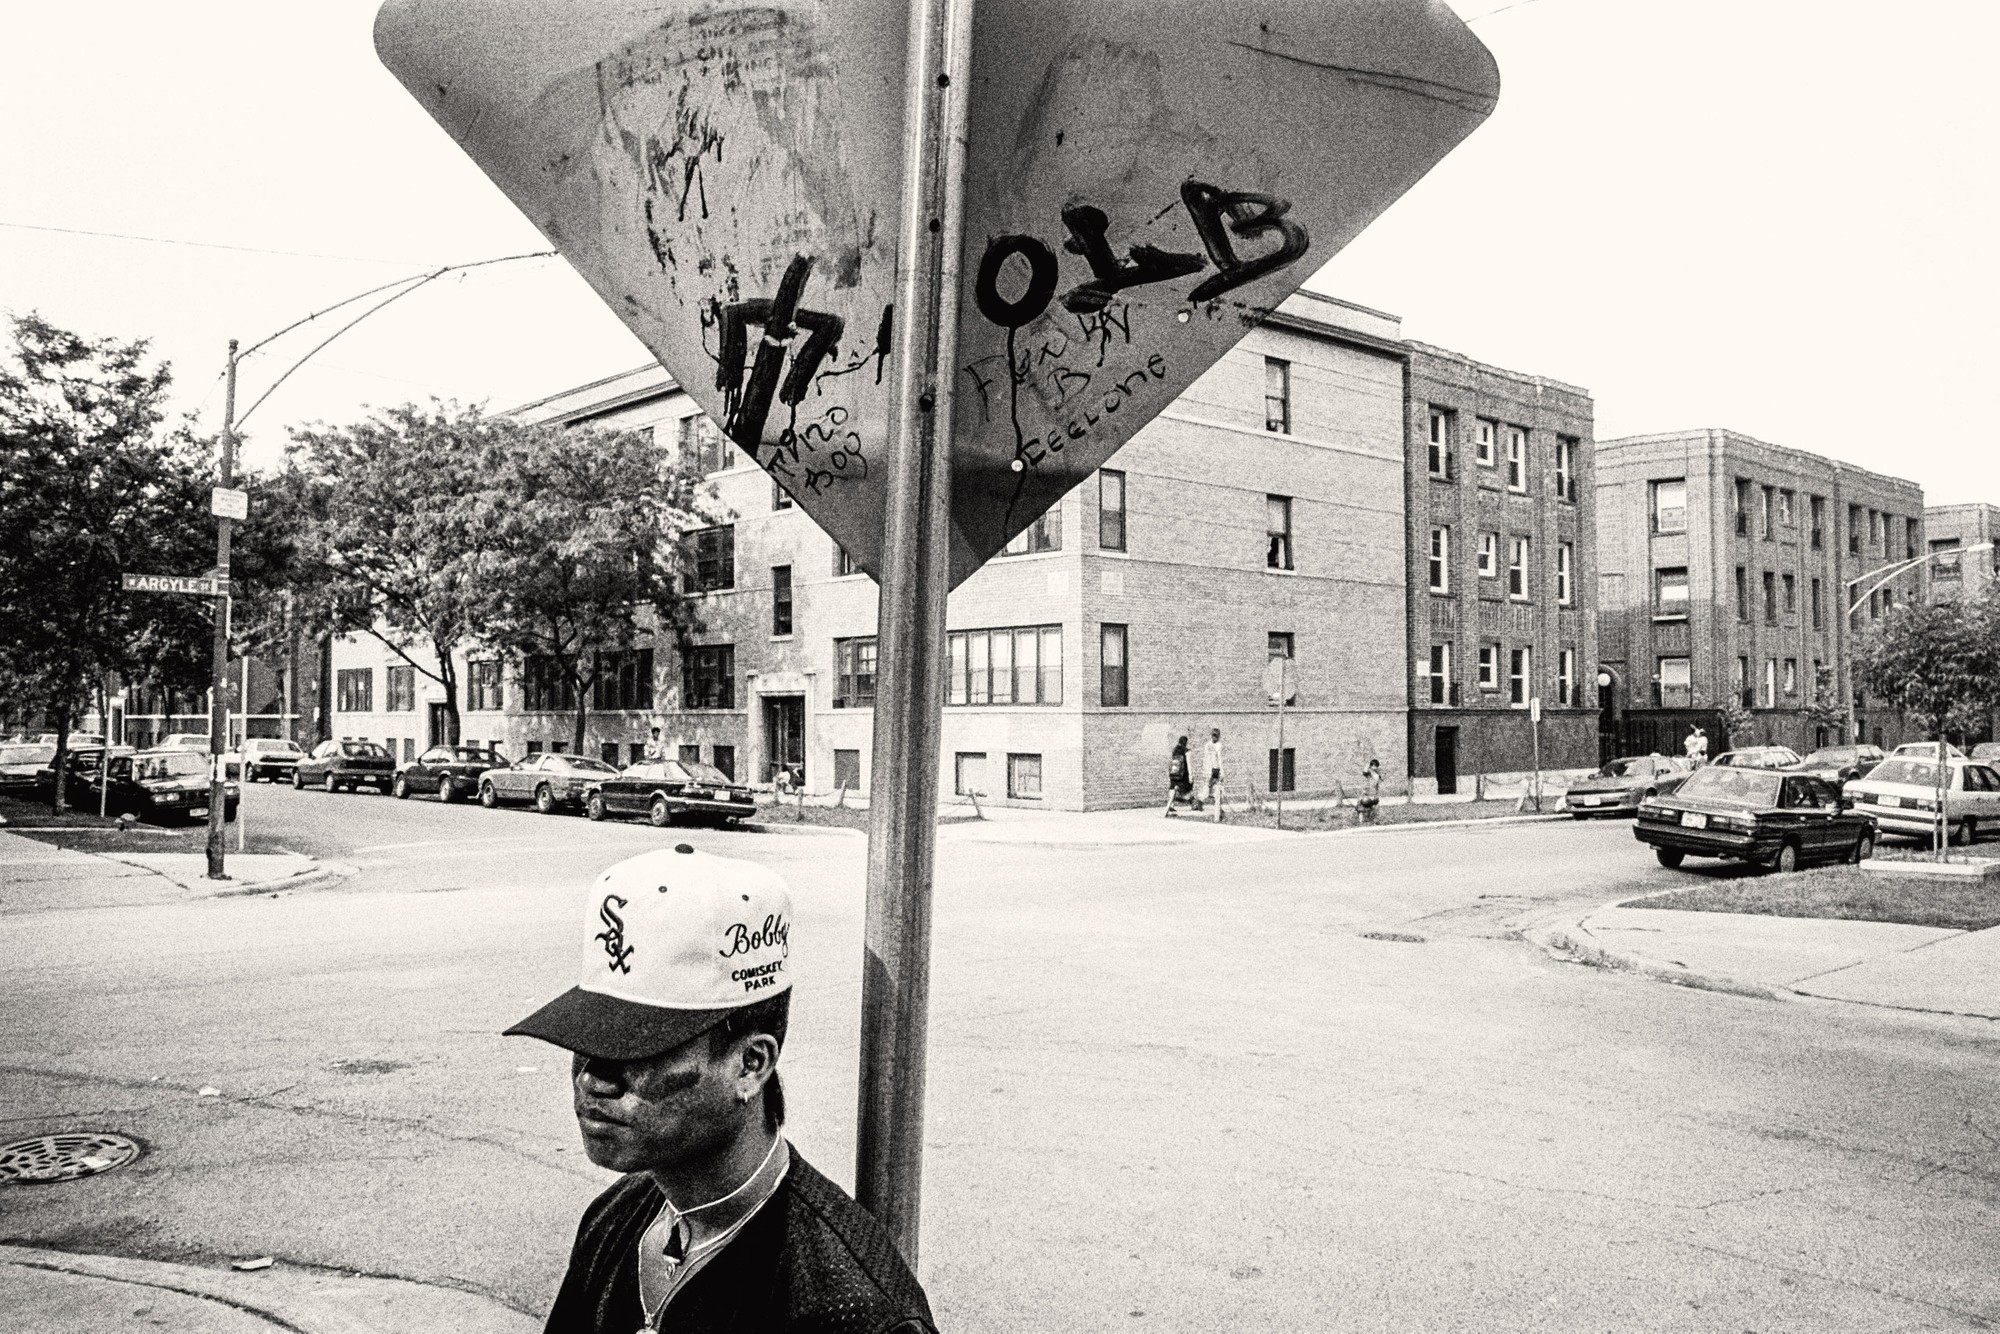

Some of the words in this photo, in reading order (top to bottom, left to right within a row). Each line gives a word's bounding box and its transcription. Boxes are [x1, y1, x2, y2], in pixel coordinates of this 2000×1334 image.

[137, 577, 197, 593] ARGYLE
[719, 913, 790, 958] Bobby
[731, 960, 784, 982] COMISKEY
[744, 975, 776, 992] PARK
